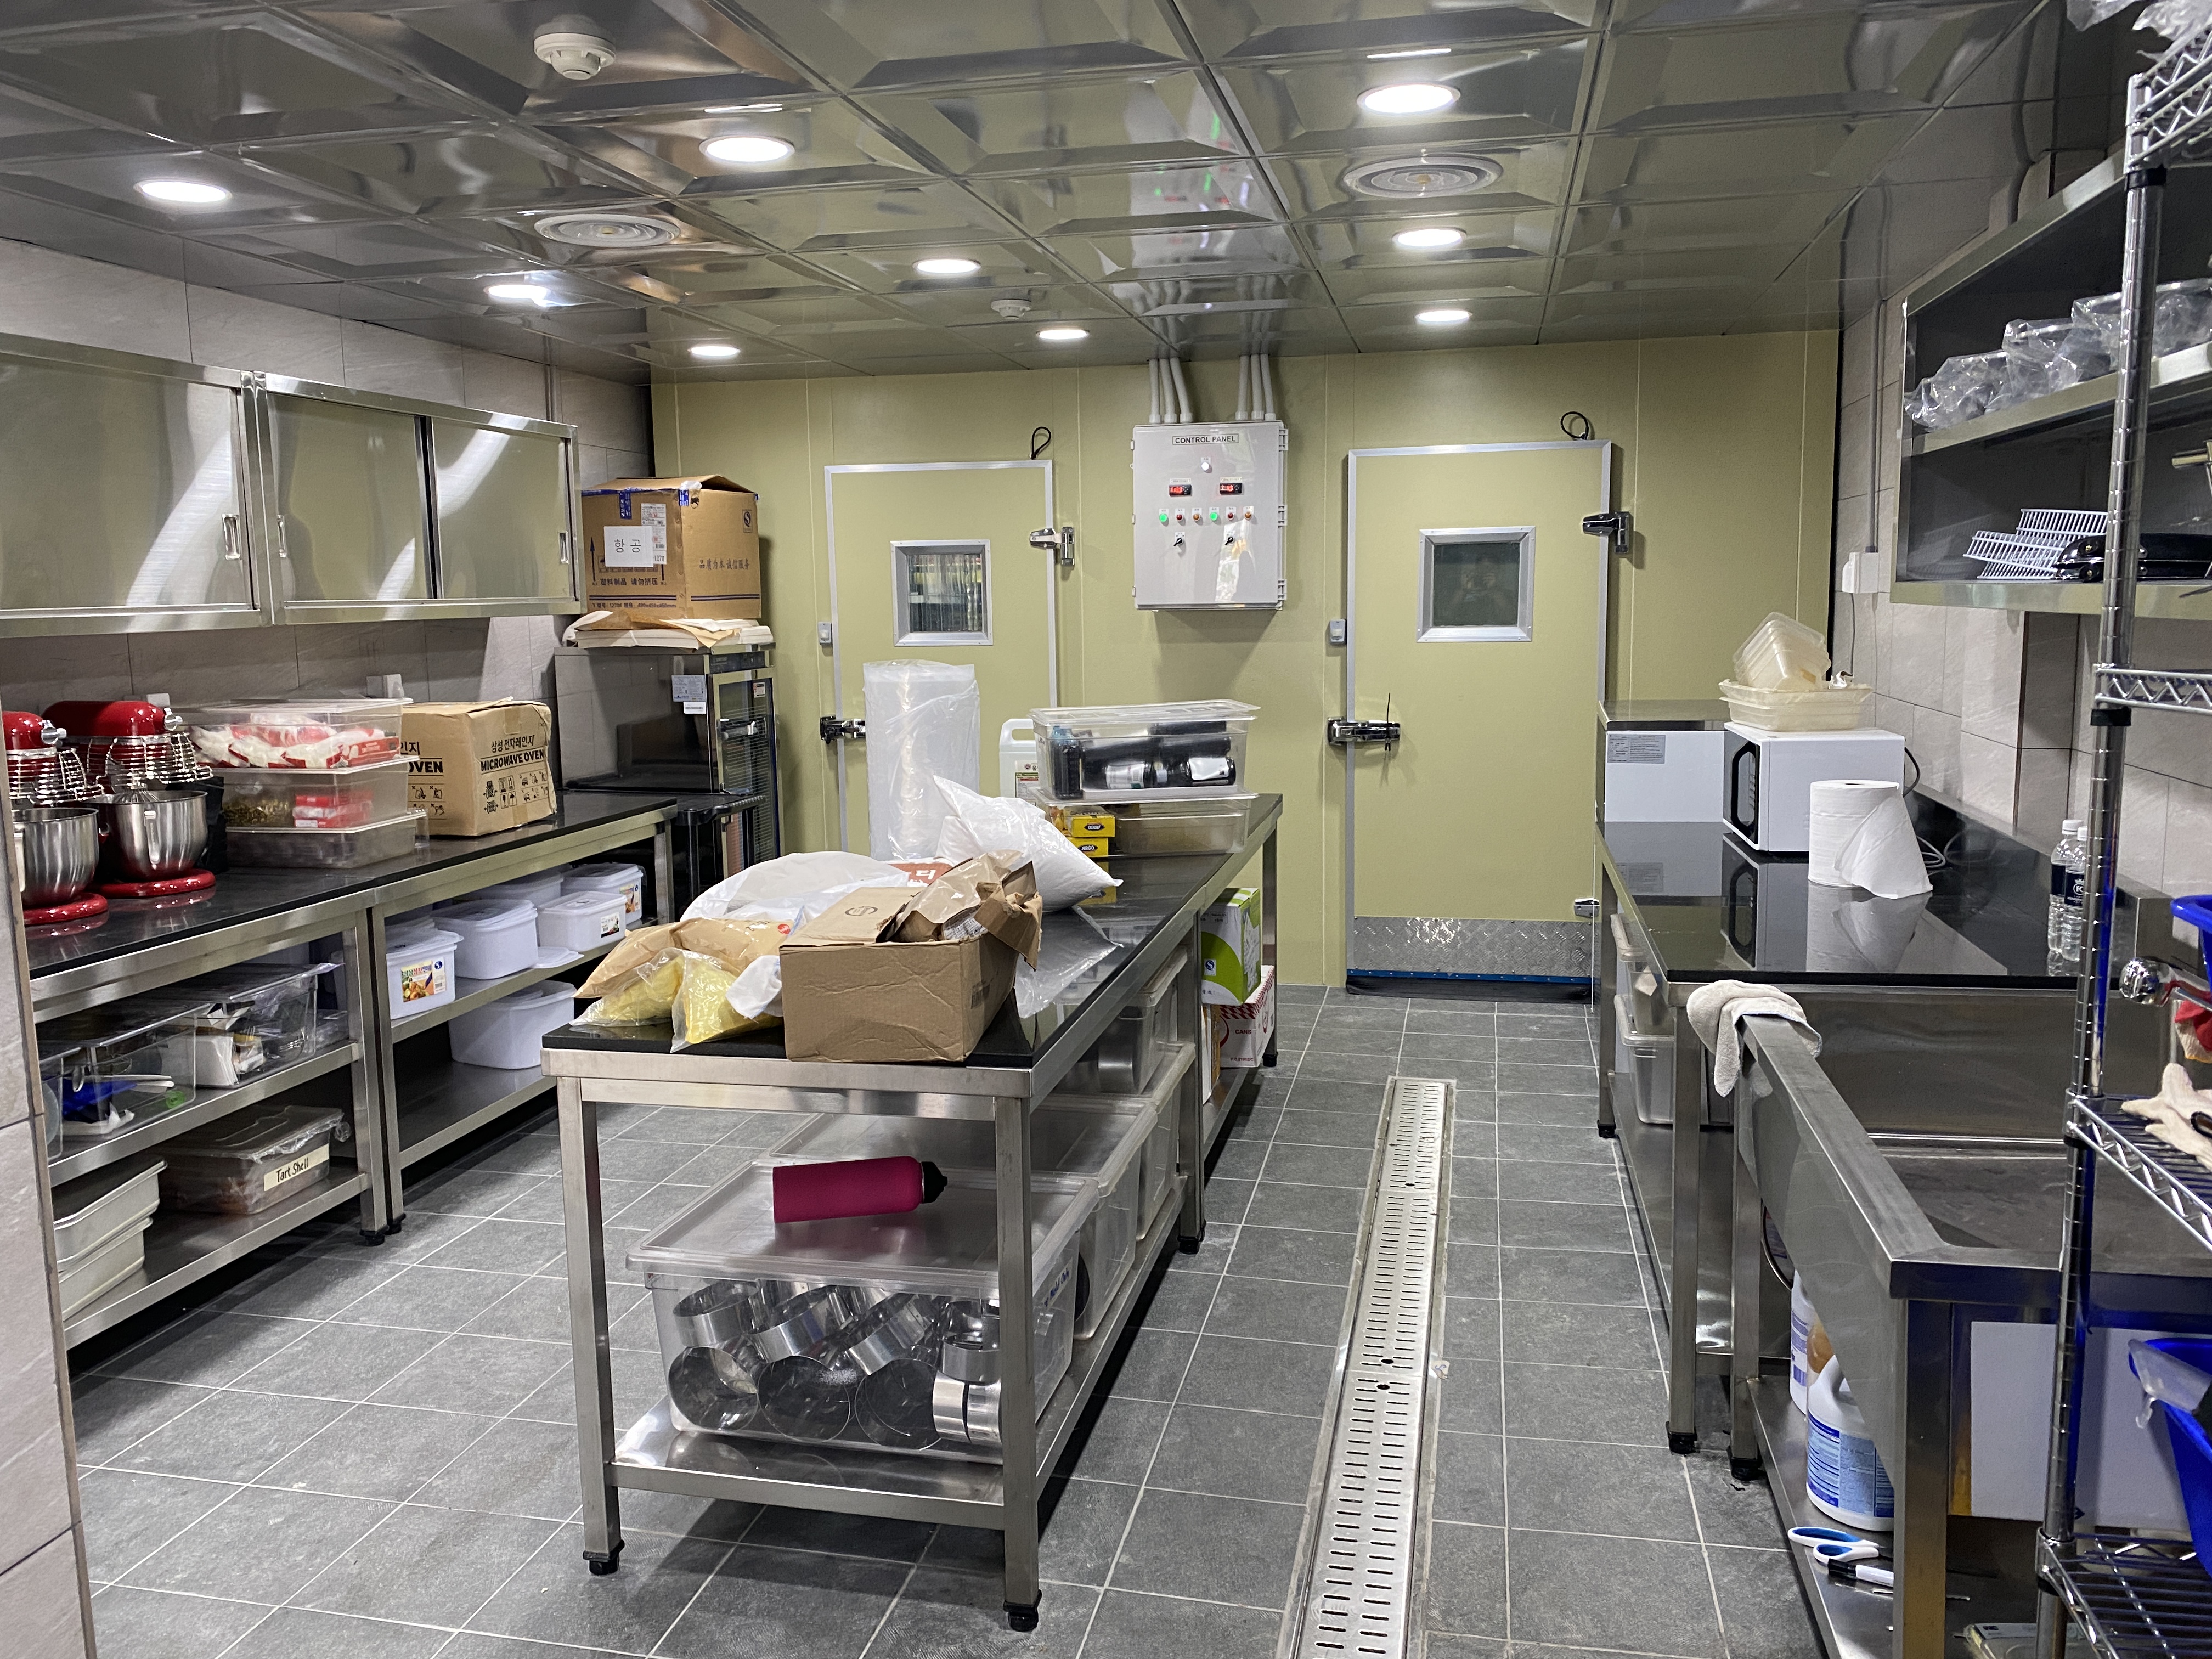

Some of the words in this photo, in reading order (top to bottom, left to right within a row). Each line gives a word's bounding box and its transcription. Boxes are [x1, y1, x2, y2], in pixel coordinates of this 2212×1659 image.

[491, 740, 503, 753] 삼성
[504, 735, 534, 751] 전자레인지
[481, 753, 523, 771] MICROWAVE
[524, 749, 544, 761] OVEN
[276, 1166, 291, 1182] Tart
[292, 1156, 308, 1175] Shell
